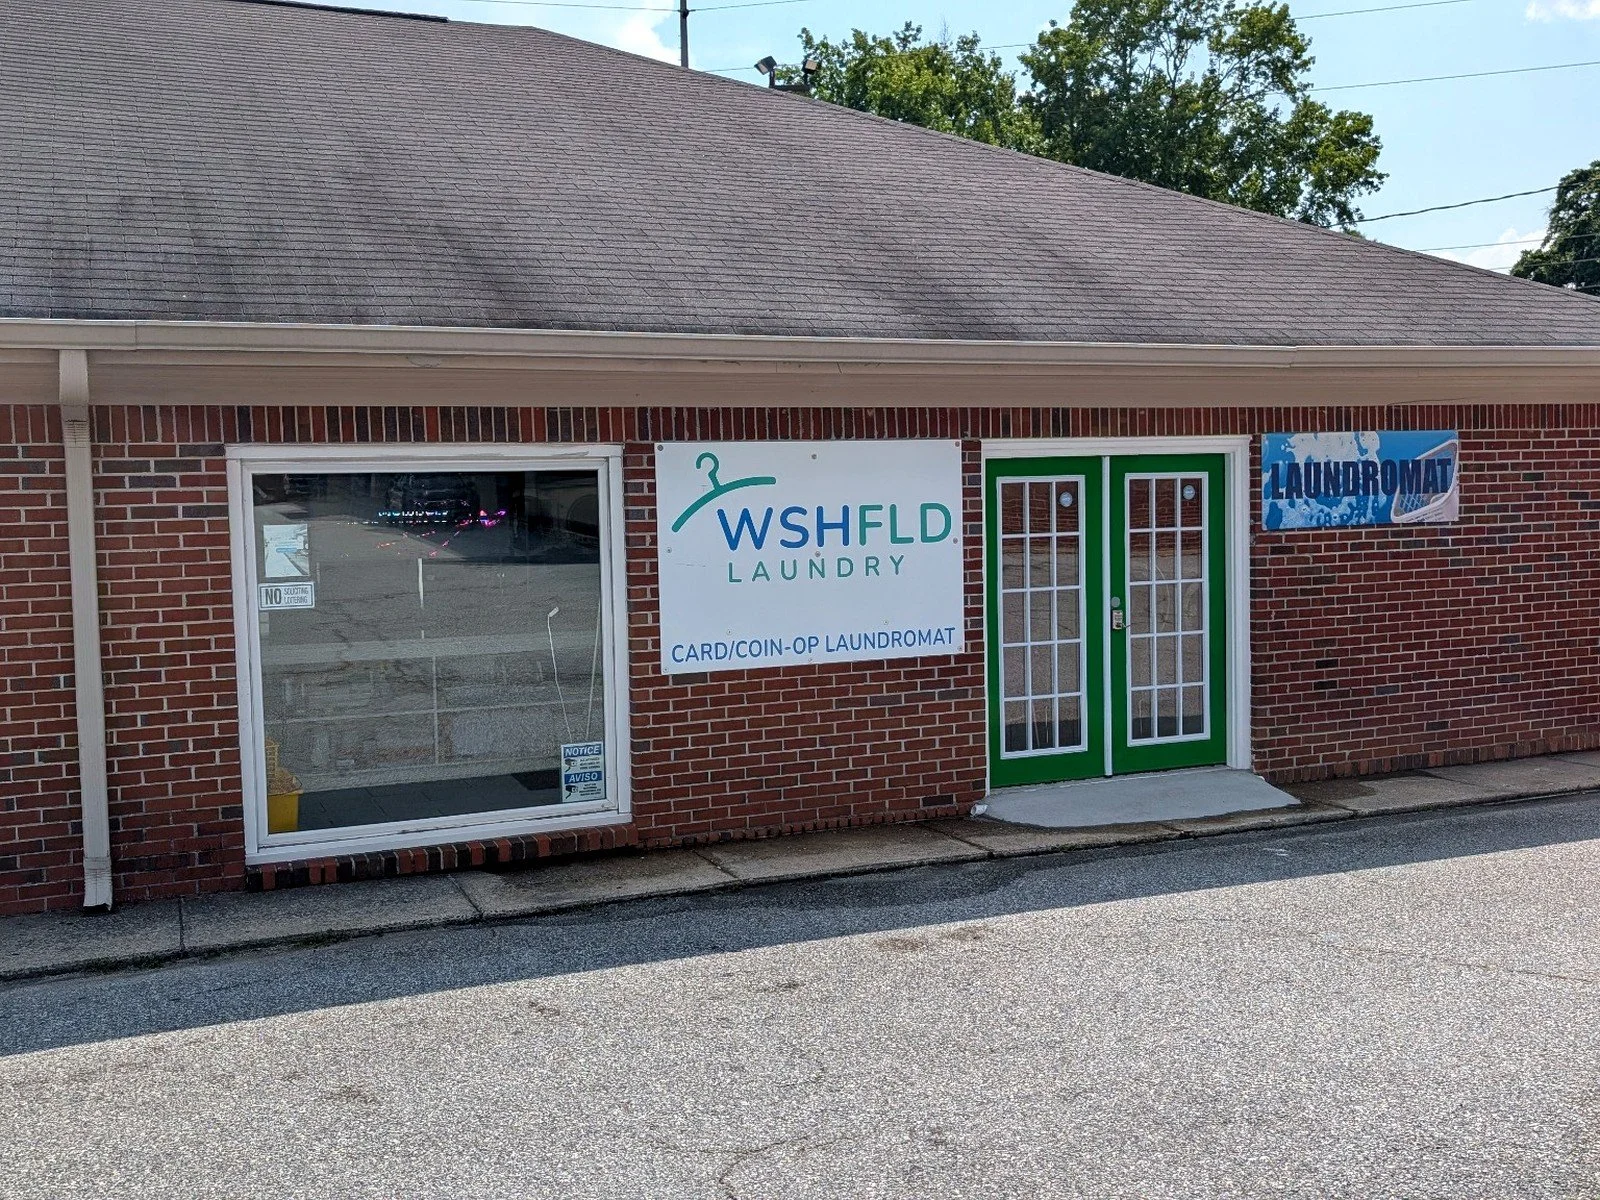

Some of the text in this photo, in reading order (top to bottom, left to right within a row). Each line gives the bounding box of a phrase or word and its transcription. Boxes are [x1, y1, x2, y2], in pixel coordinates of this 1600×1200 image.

[1271, 458, 1452, 500] LAUNDROMAT
[717, 502, 952, 551] WSHFLD
[728, 554, 905, 584] LAUNDRY
[265, 588, 282, 605] NO
[284, 586, 309, 596] SOLICITING
[284, 595, 308, 605] LOITERING
[671, 626, 956, 664] CARD/COIN-OP LAUNDROMAT
[565, 745, 600, 757] NOTICE
[568, 772, 598, 783] AVISO
